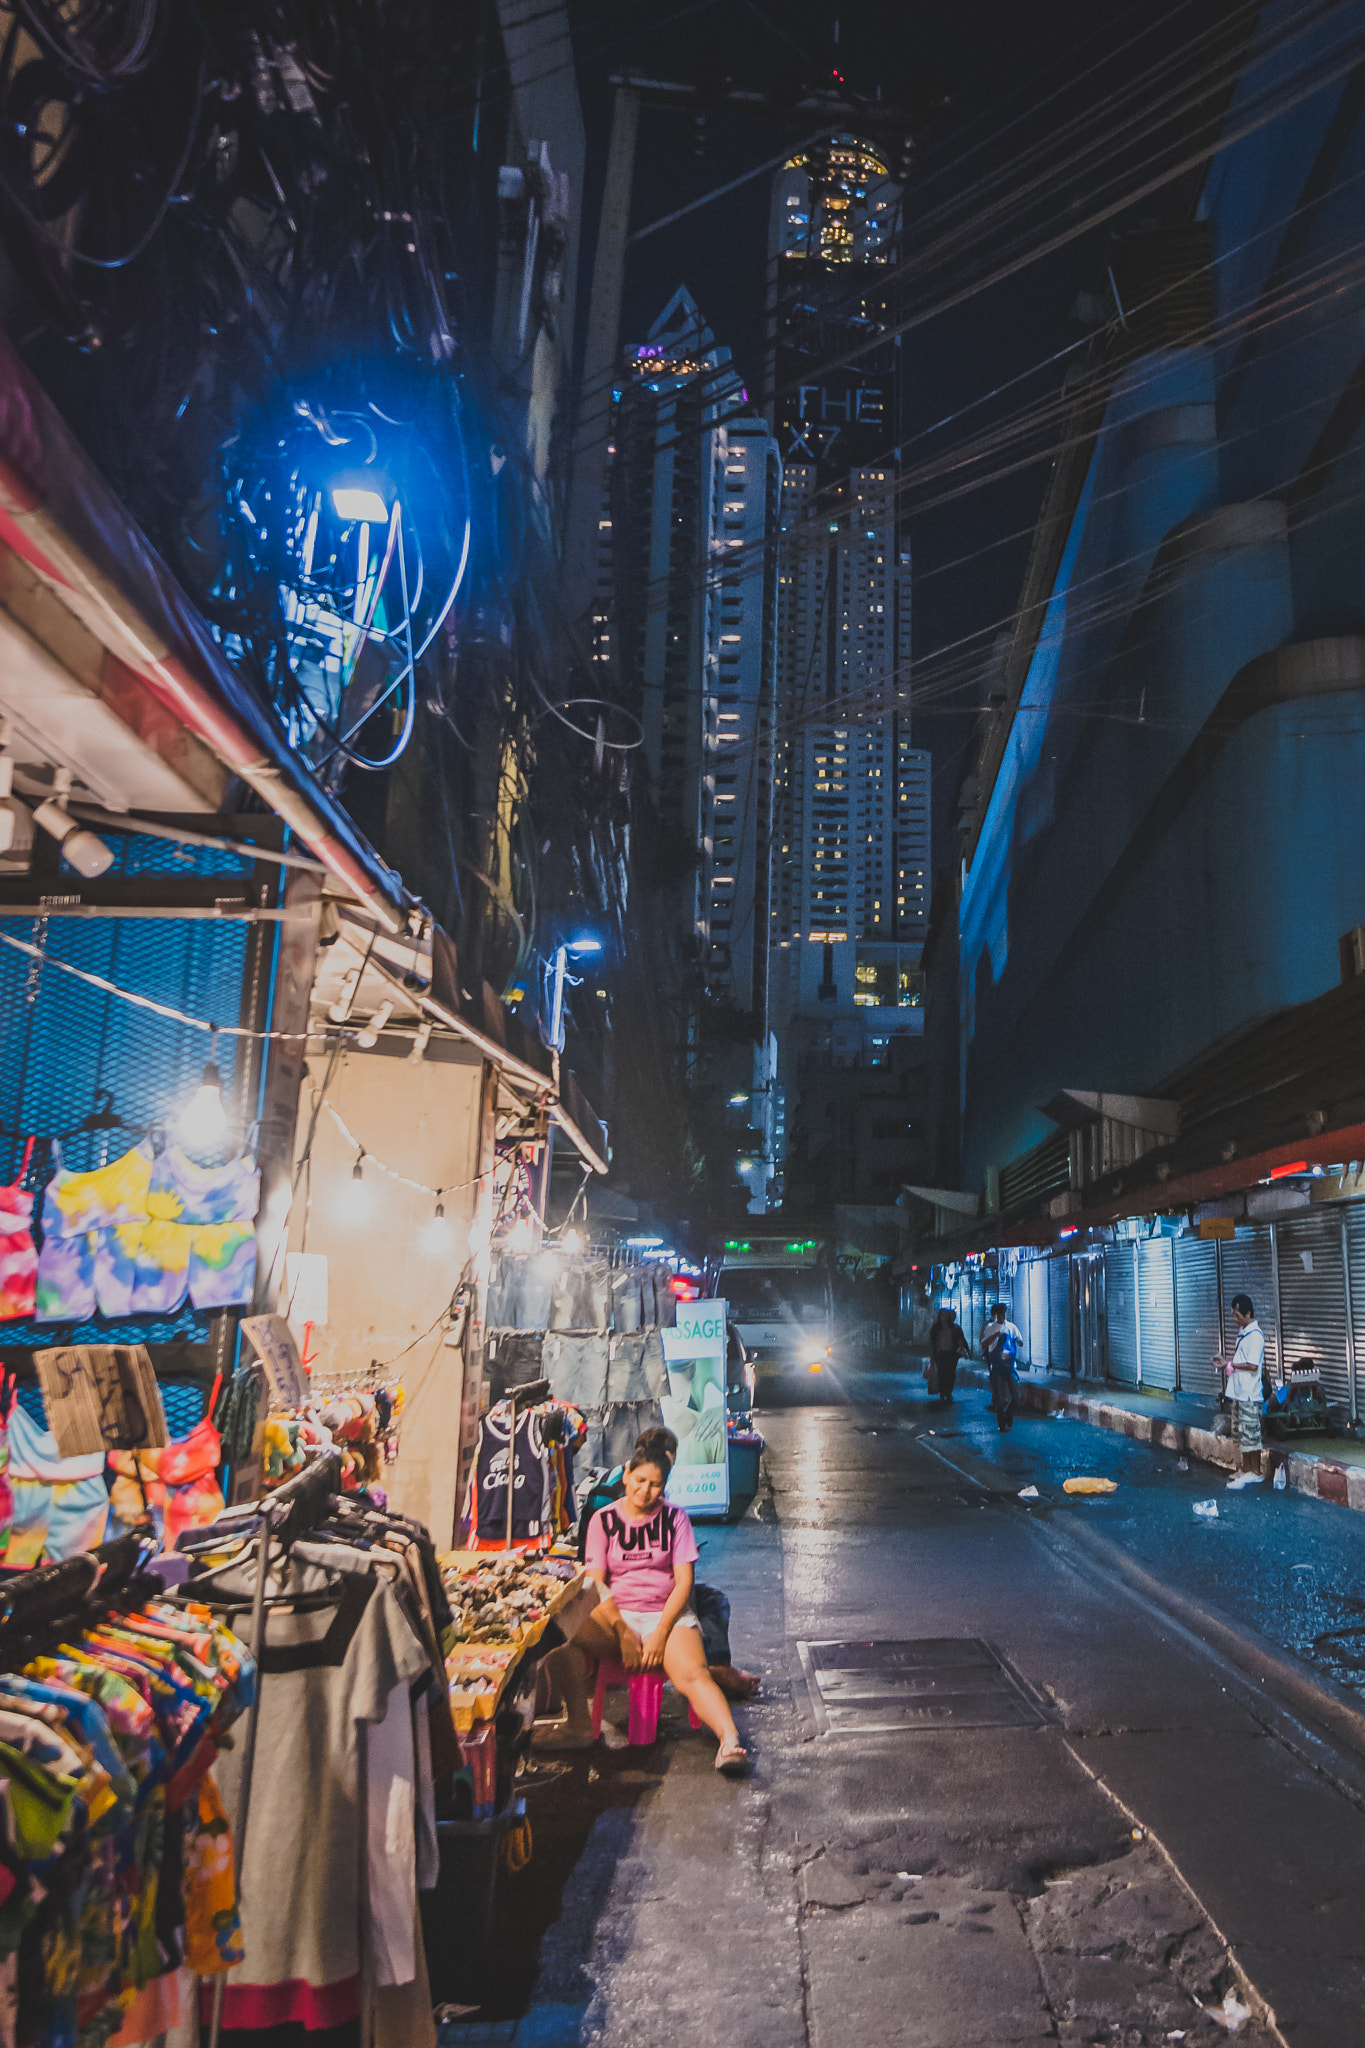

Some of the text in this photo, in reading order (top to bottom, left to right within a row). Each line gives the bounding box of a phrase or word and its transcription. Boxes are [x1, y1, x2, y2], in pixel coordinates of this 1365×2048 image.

[799, 386, 882, 423] THE
[686, 1482, 717, 1493] 6200
[601, 1505, 678, 1551] PUNK
